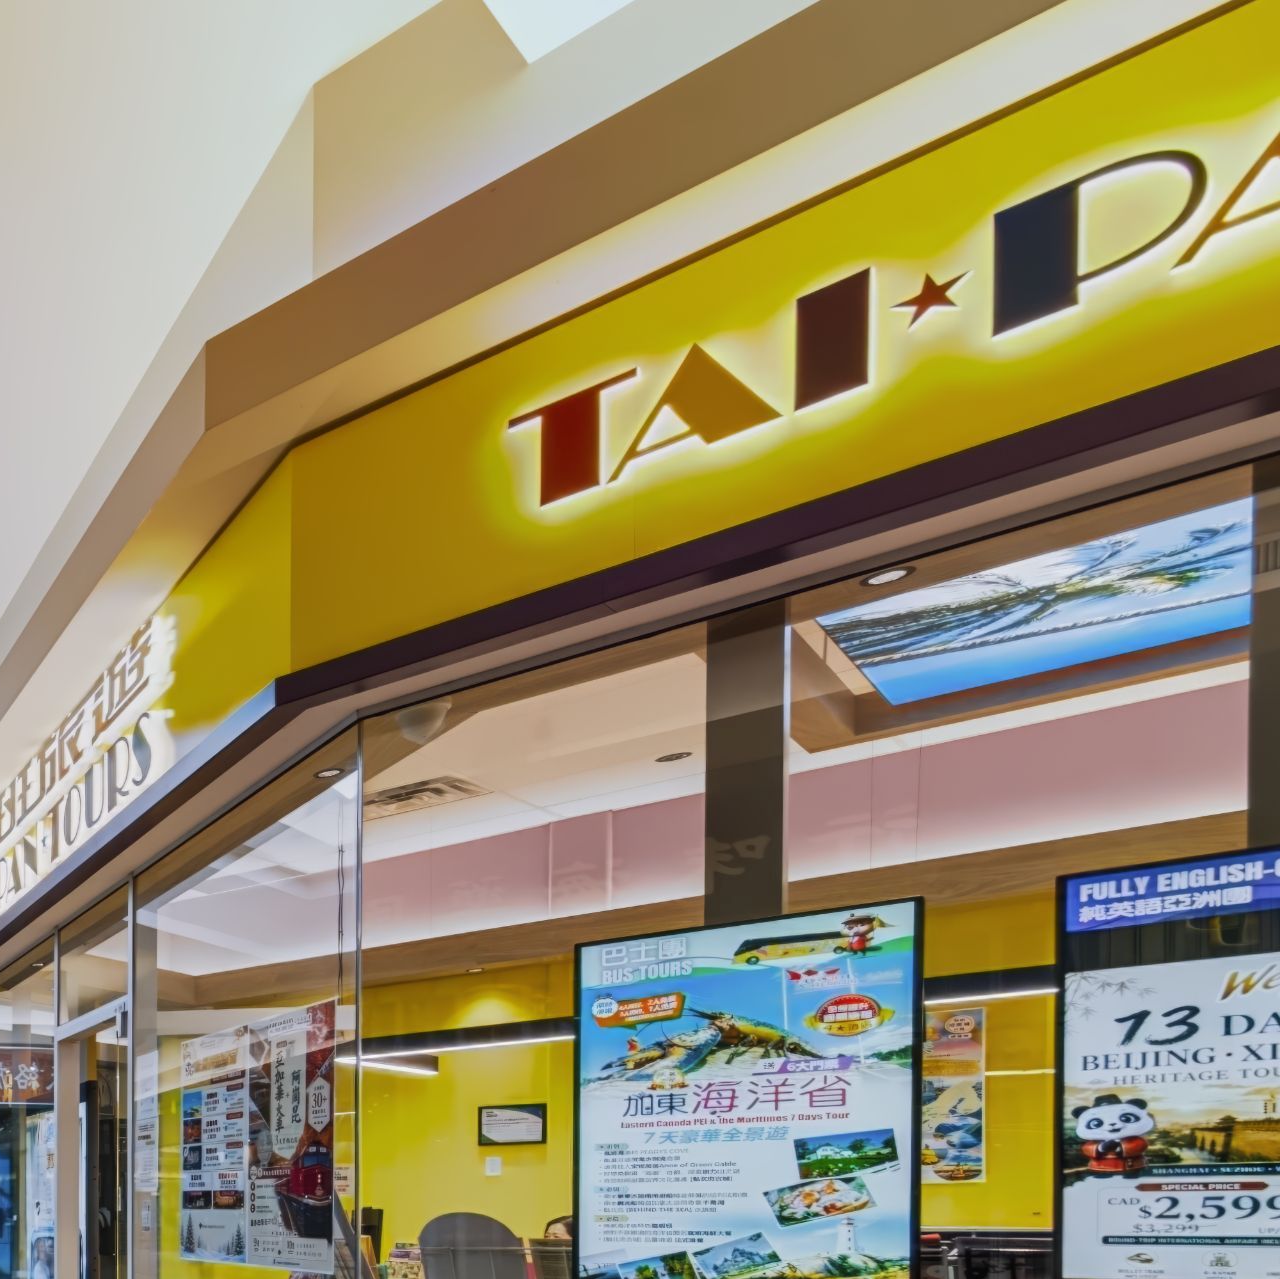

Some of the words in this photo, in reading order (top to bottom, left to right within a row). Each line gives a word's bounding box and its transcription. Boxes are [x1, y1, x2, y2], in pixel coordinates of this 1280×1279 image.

[508, 267, 871, 507] TAI
[46, 712, 152, 863] TOURS
[1079, 876, 1150, 902] FULLY
[601, 937, 687, 967] 巴士團
[602, 967, 634, 985] BUS
[639, 959, 693, 981] TOURS
[1114, 1005, 1201, 1047] 13
[1081, 1047, 1216, 1072] BEIJING
[1113, 1070, 1229, 1086] HERITAGE
[798, 1113, 823, 1122] Days
[826, 1111, 850, 1120] Tour
[1107, 1197, 1140, 1206] CAD
